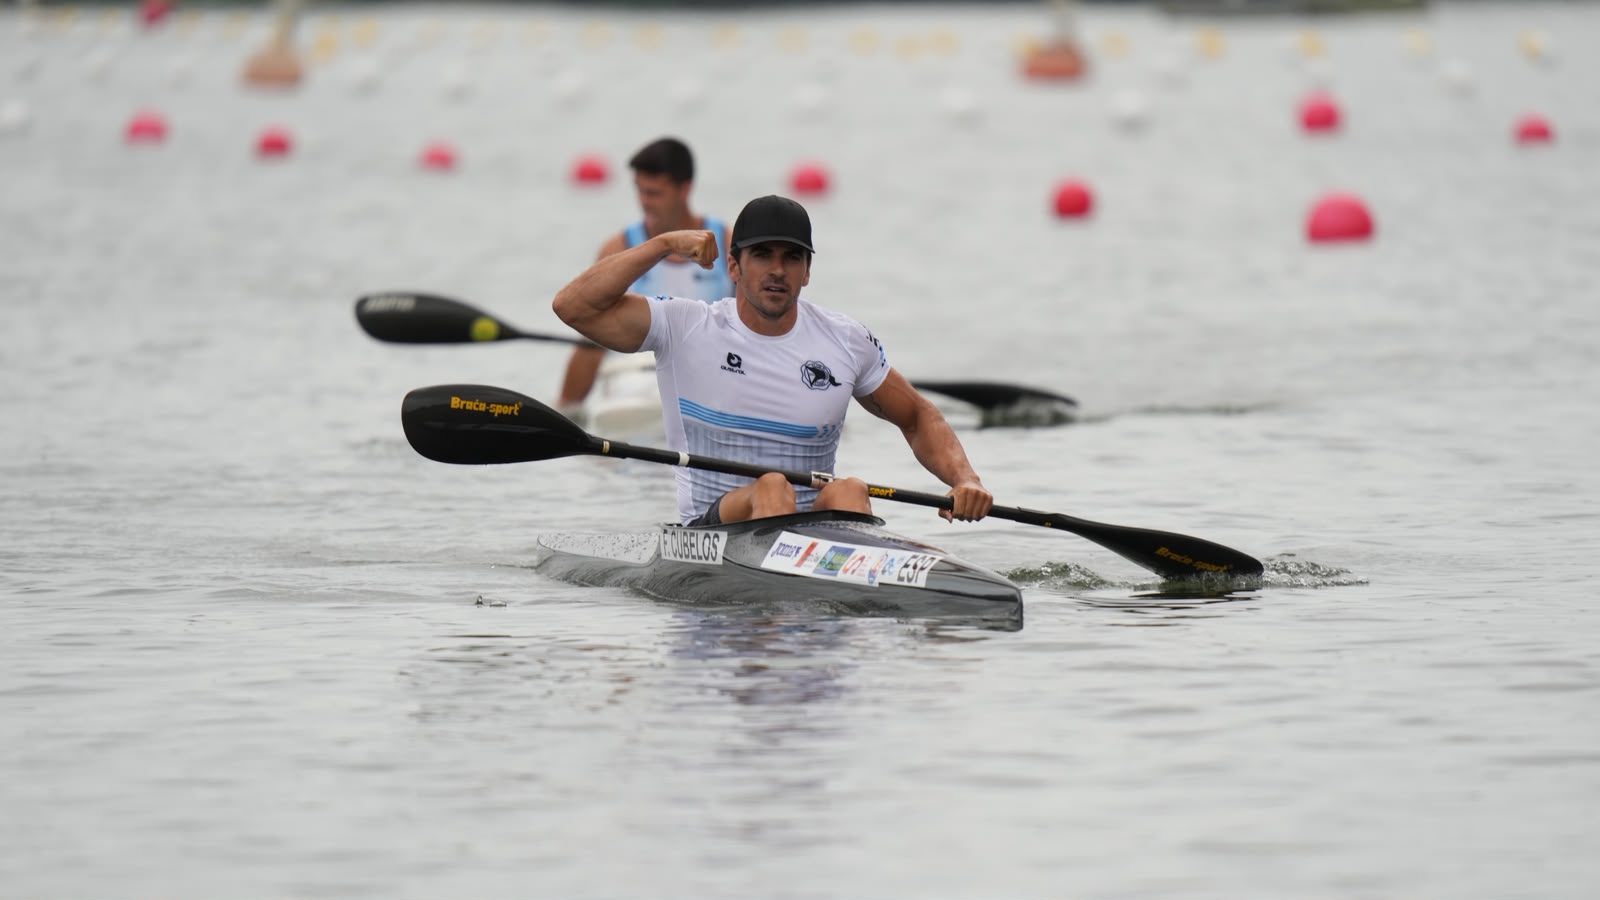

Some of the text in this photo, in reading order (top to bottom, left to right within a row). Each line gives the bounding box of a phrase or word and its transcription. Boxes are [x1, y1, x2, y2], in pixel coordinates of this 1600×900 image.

[663, 529, 720, 562] F. CUBELOS
[897, 554, 936, 583] ESP
